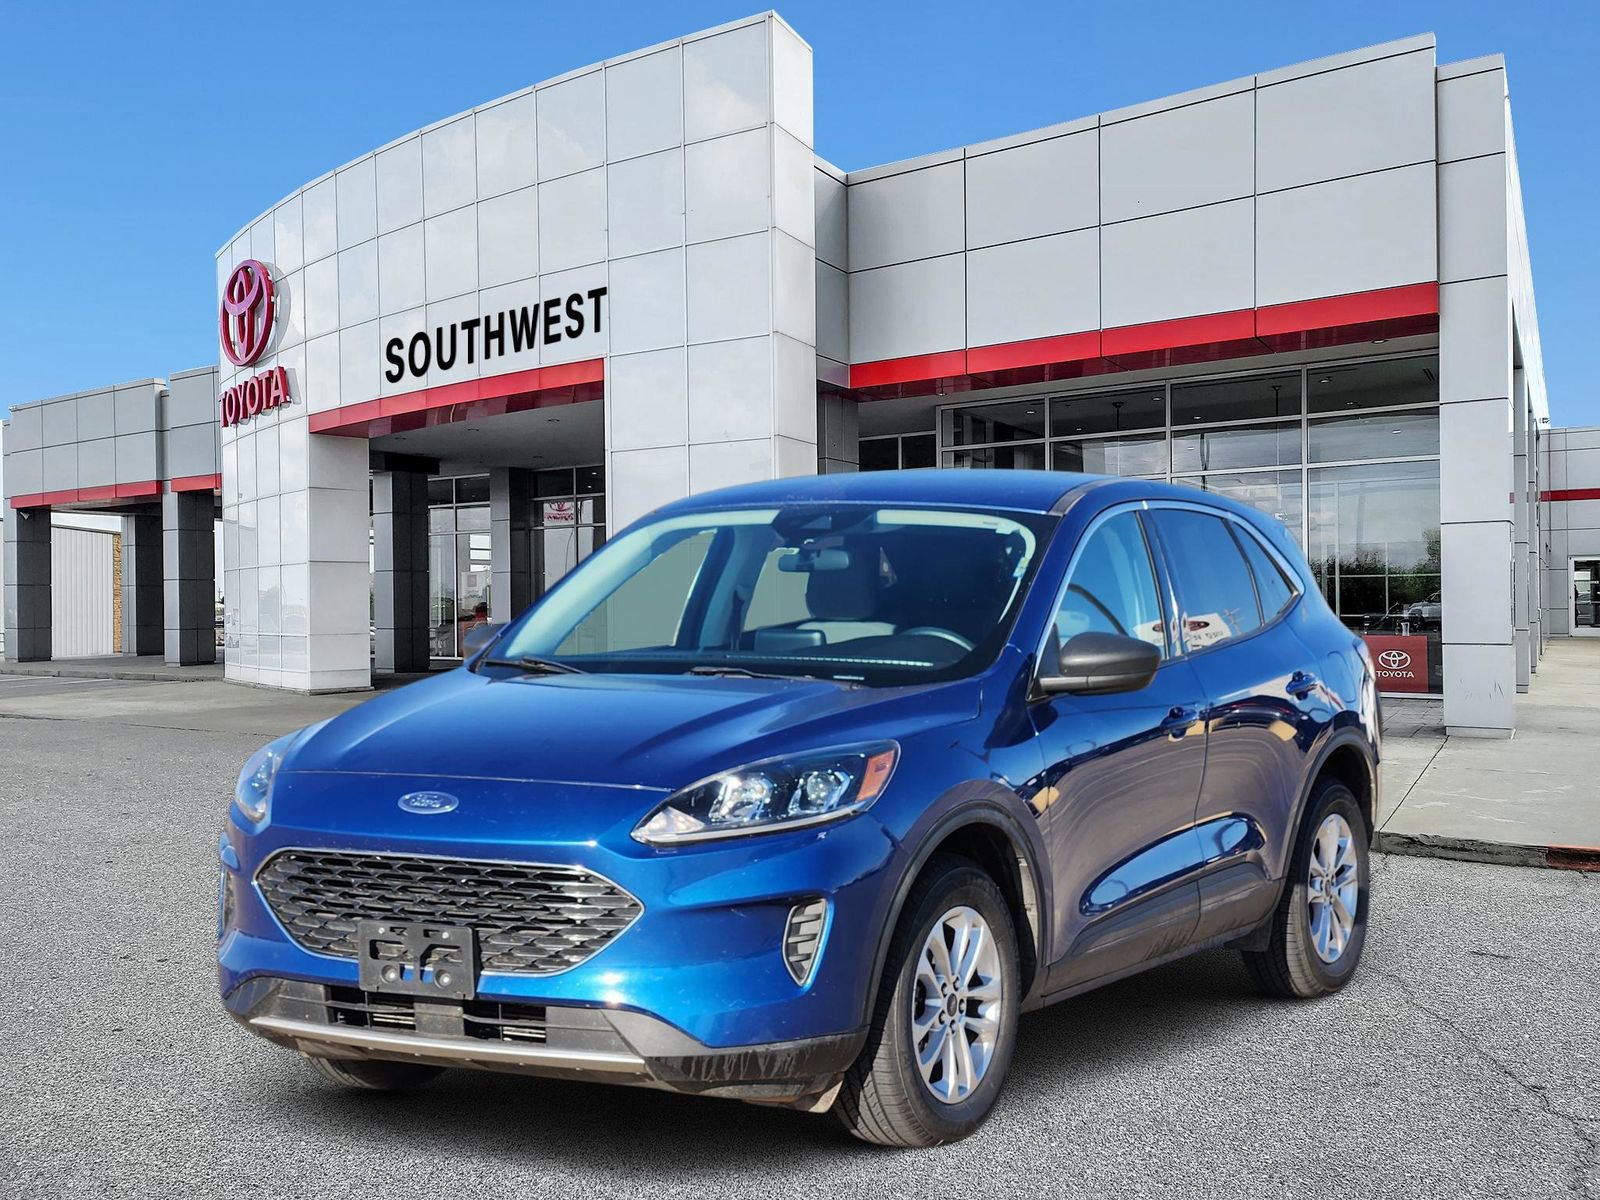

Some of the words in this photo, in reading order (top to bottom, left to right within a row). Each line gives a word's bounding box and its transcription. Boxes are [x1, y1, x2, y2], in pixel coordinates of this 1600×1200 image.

[385, 286, 608, 384] SOUTHWEST
[219, 366, 291, 427] TOYOTA
[1375, 670, 1415, 678] TOYOTA
